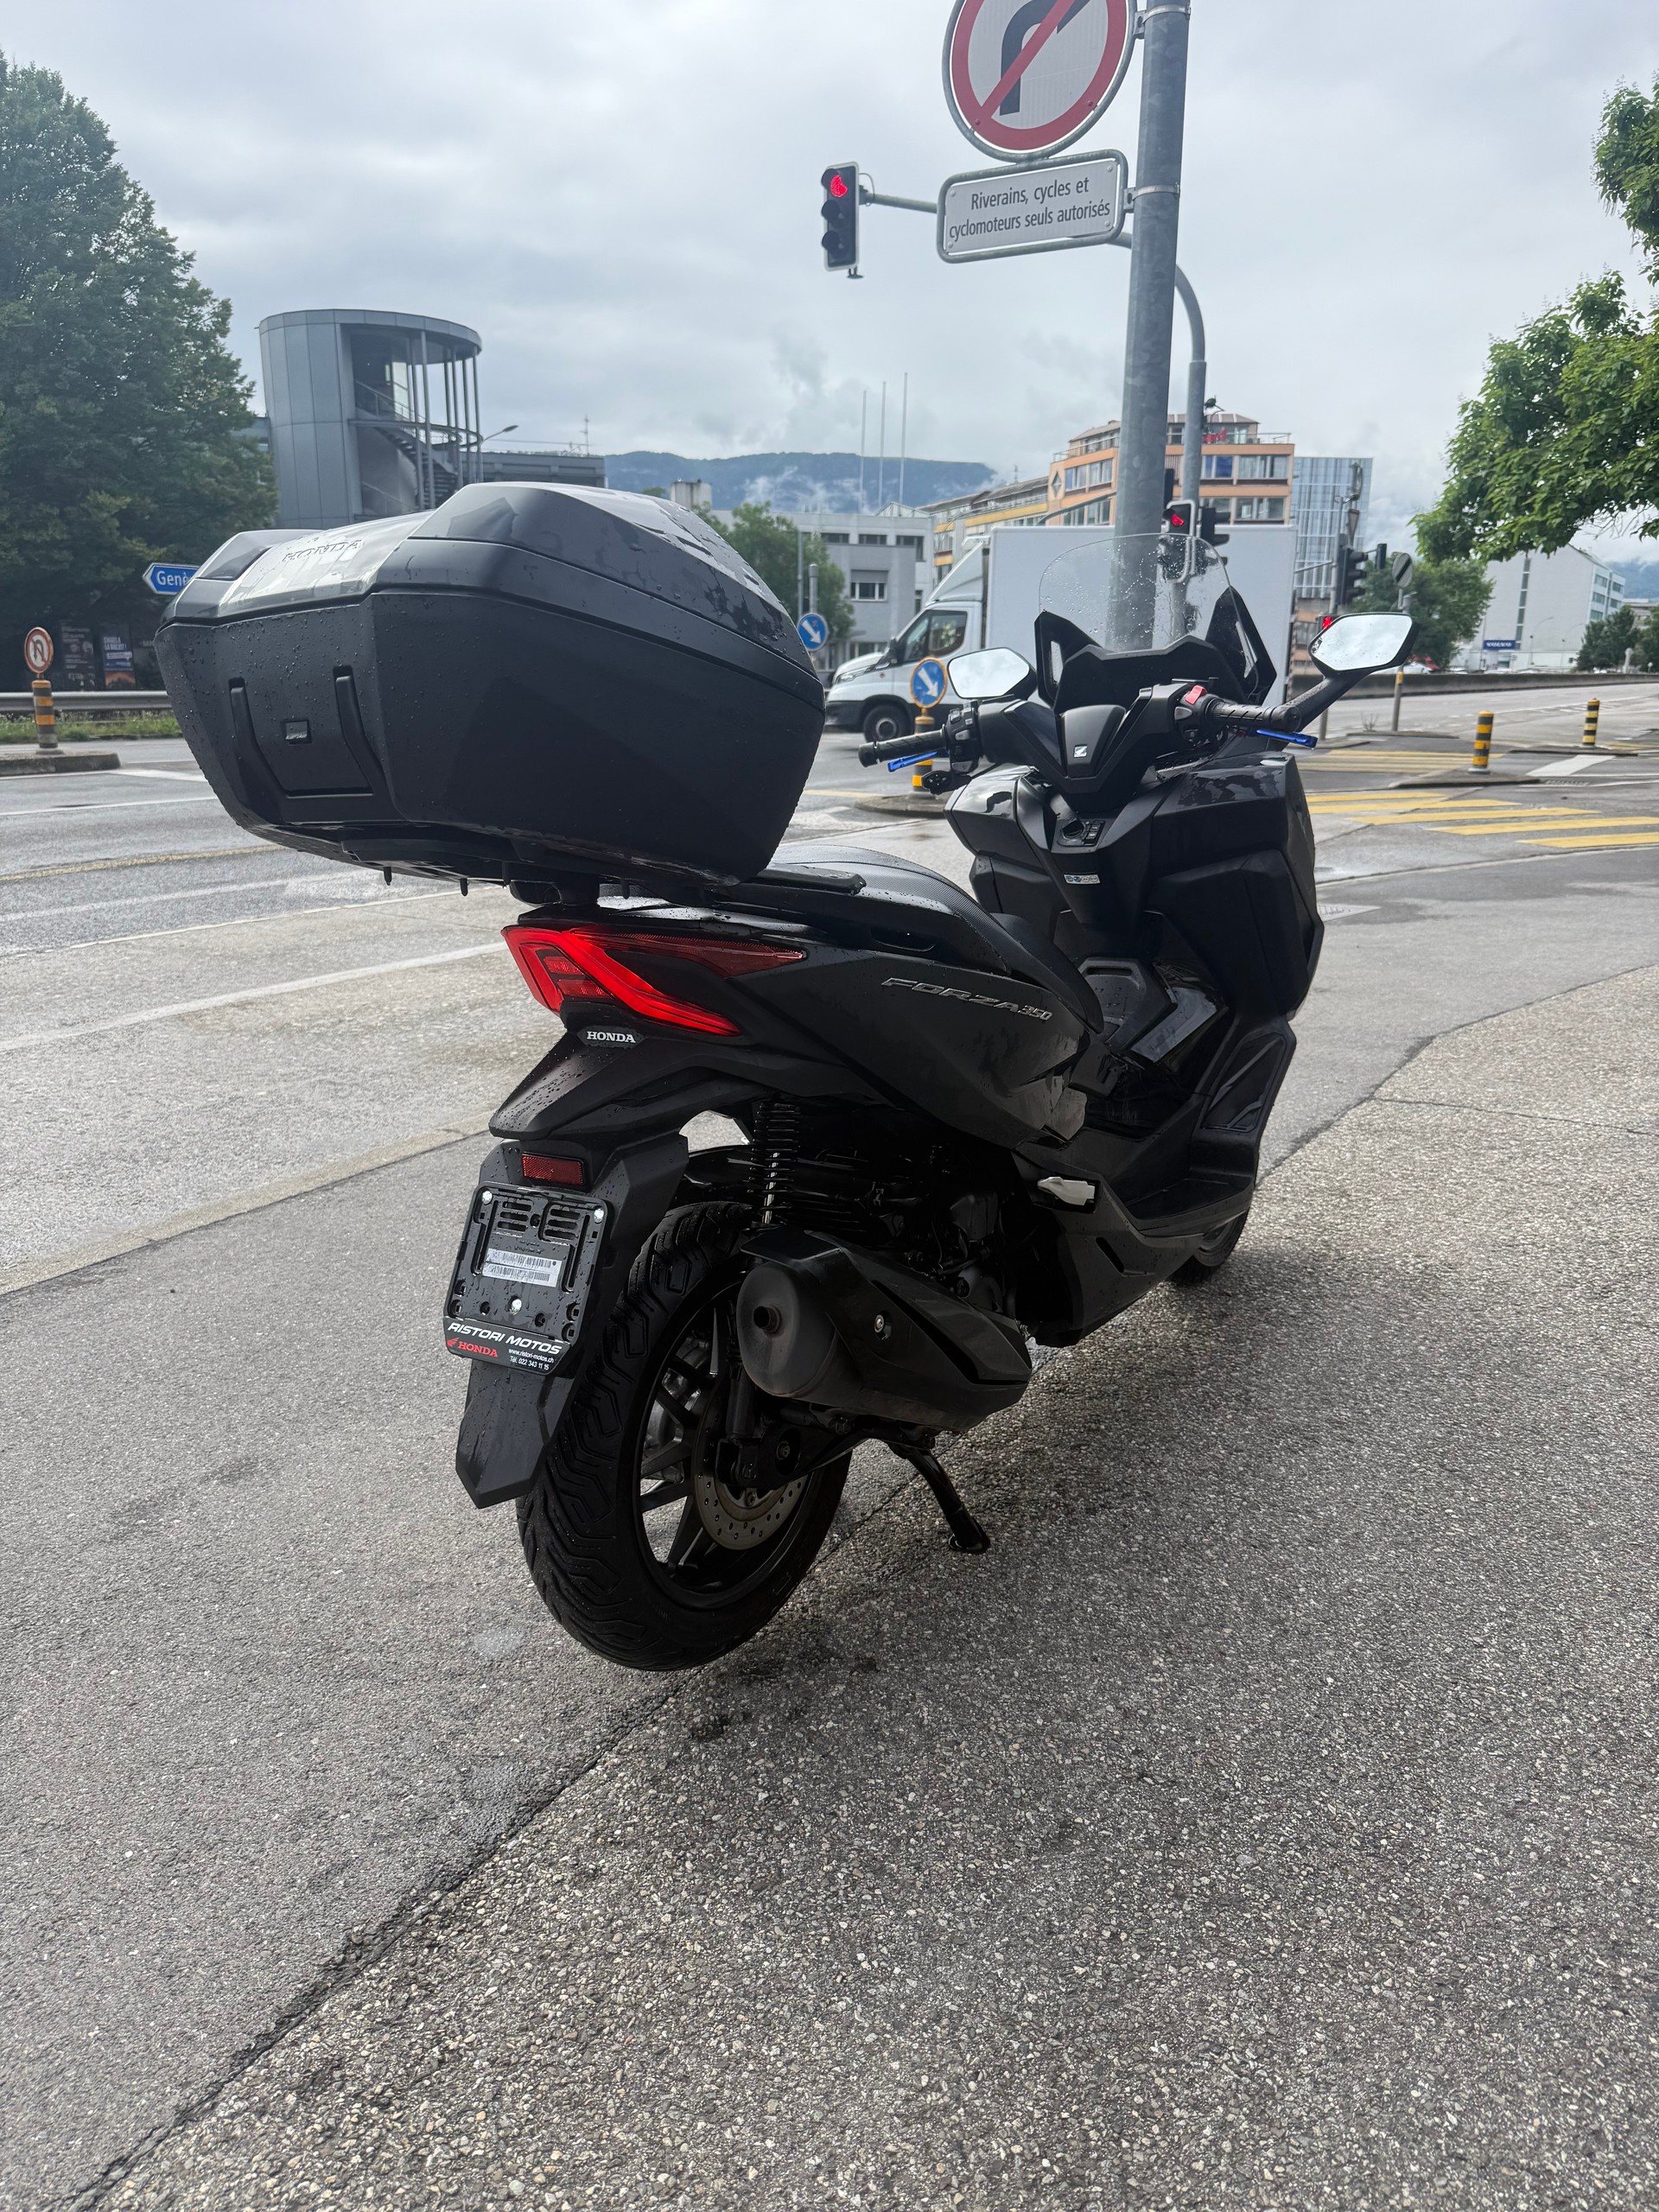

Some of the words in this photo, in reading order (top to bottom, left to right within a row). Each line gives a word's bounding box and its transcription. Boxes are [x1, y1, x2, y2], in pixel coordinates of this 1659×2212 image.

[971, 187, 1028, 210] Riverains,
[1033, 180, 1071, 204] cycles
[1076, 177, 1090, 194] et
[950, 215, 1021, 242] cyclomoteurs
[1025, 207, 1053, 227] seuls
[1057, 199, 1110, 223] autorisés
[881, 977, 1019, 1013] FORZA
[1017, 1005, 1052, 1020] 350
[587, 1031, 636, 1043] HONDA
[448, 1322, 505, 1342] RISTORI
[505, 1336, 563, 1355] MOTOS
[458, 1341, 499, 1357] HONDA
[508, 1348, 554, 1363] www.ristori-motos.ch
